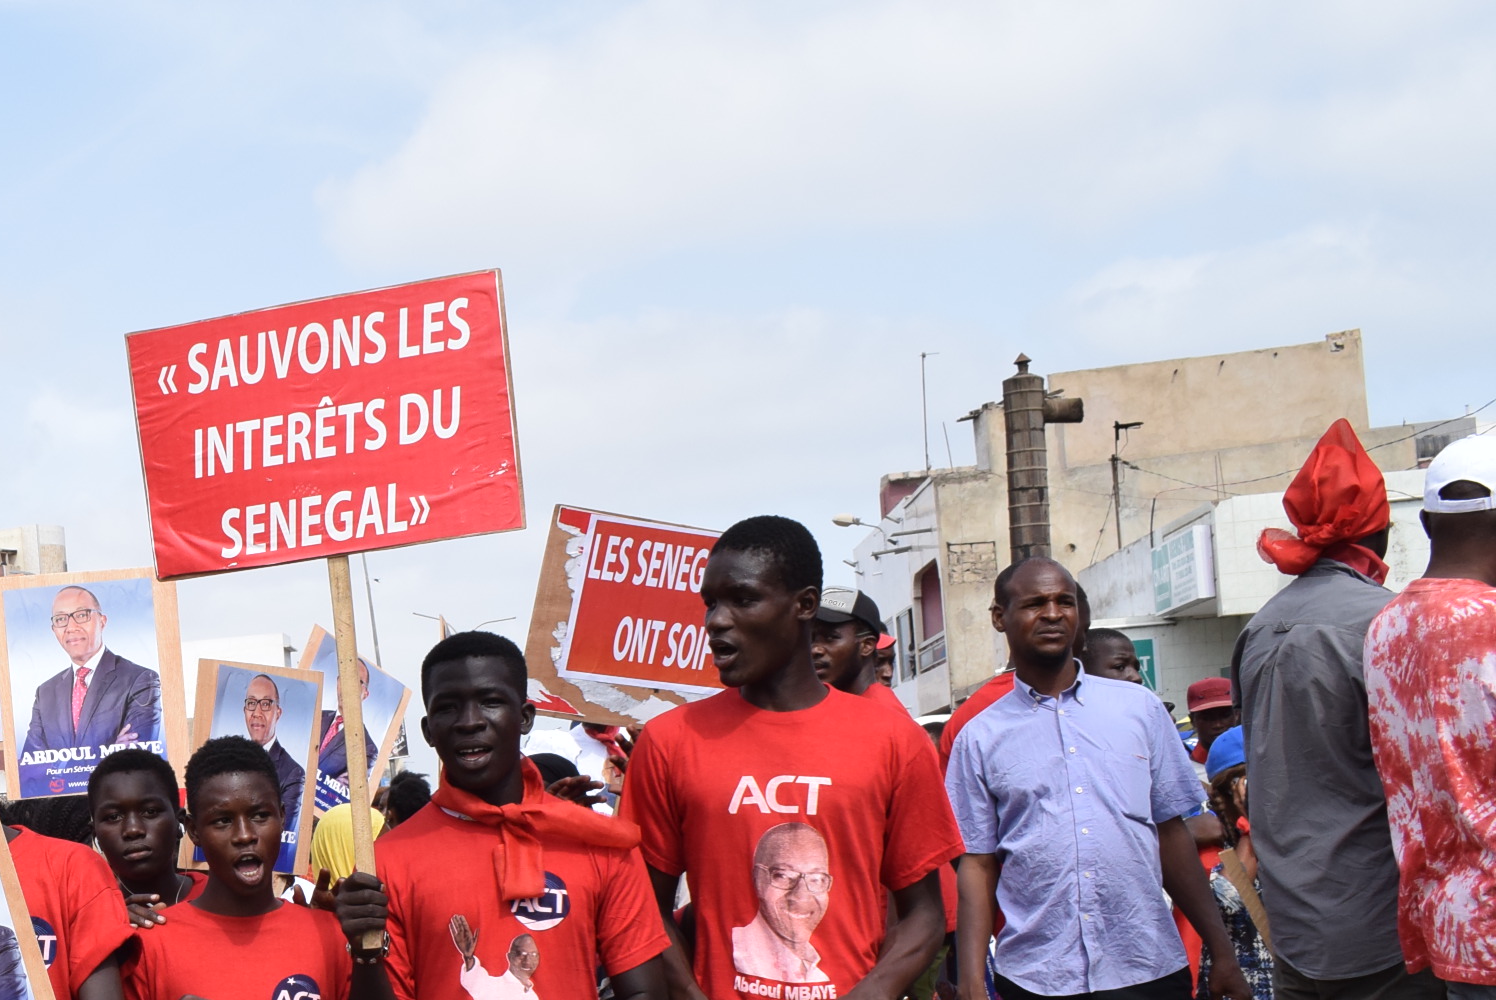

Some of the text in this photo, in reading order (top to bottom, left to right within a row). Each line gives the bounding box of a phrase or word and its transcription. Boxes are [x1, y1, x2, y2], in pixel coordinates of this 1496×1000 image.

[187, 311, 386, 395] SAUVONS
[398, 297, 471, 360] LES
[194, 385, 461, 479] INTERÊTS DU
[587, 533, 710, 593] LES SENEG
[613, 615, 667, 665] ONT
[20, 745, 96, 766] ABDOUL
[727, 774, 833, 815] ACT
[733, 975, 783, 1000] Abdoul
